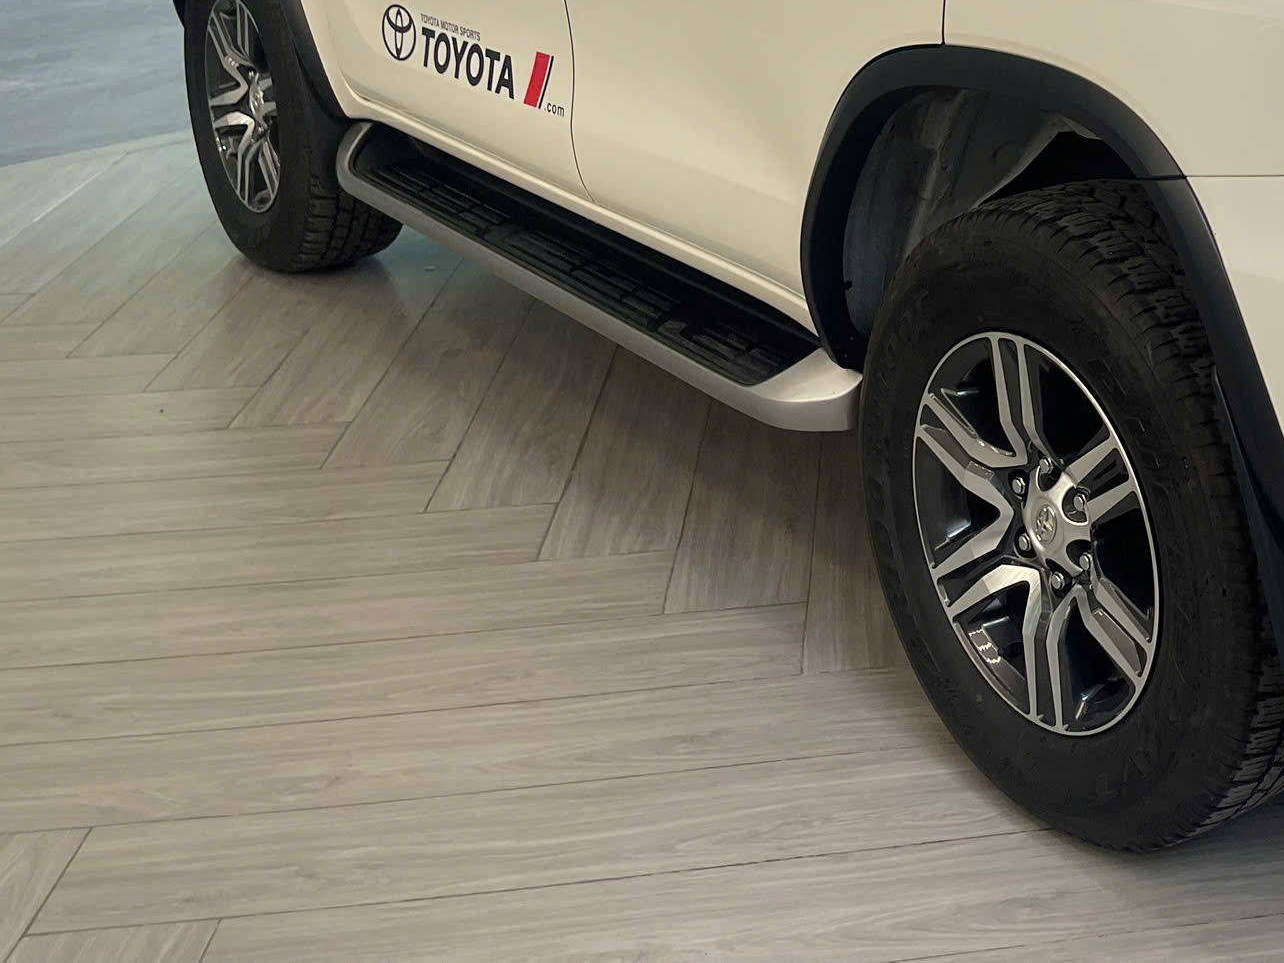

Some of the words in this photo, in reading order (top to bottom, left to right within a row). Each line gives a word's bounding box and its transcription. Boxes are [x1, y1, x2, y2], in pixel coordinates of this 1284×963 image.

[420, 13, 440, 28] TOYOTA
[440, 20, 459, 34] MOTOR
[459, 26, 481, 42] SPORTS
[421, 26, 515, 100] TOYOTA
[544, 102, 565, 118] .com
